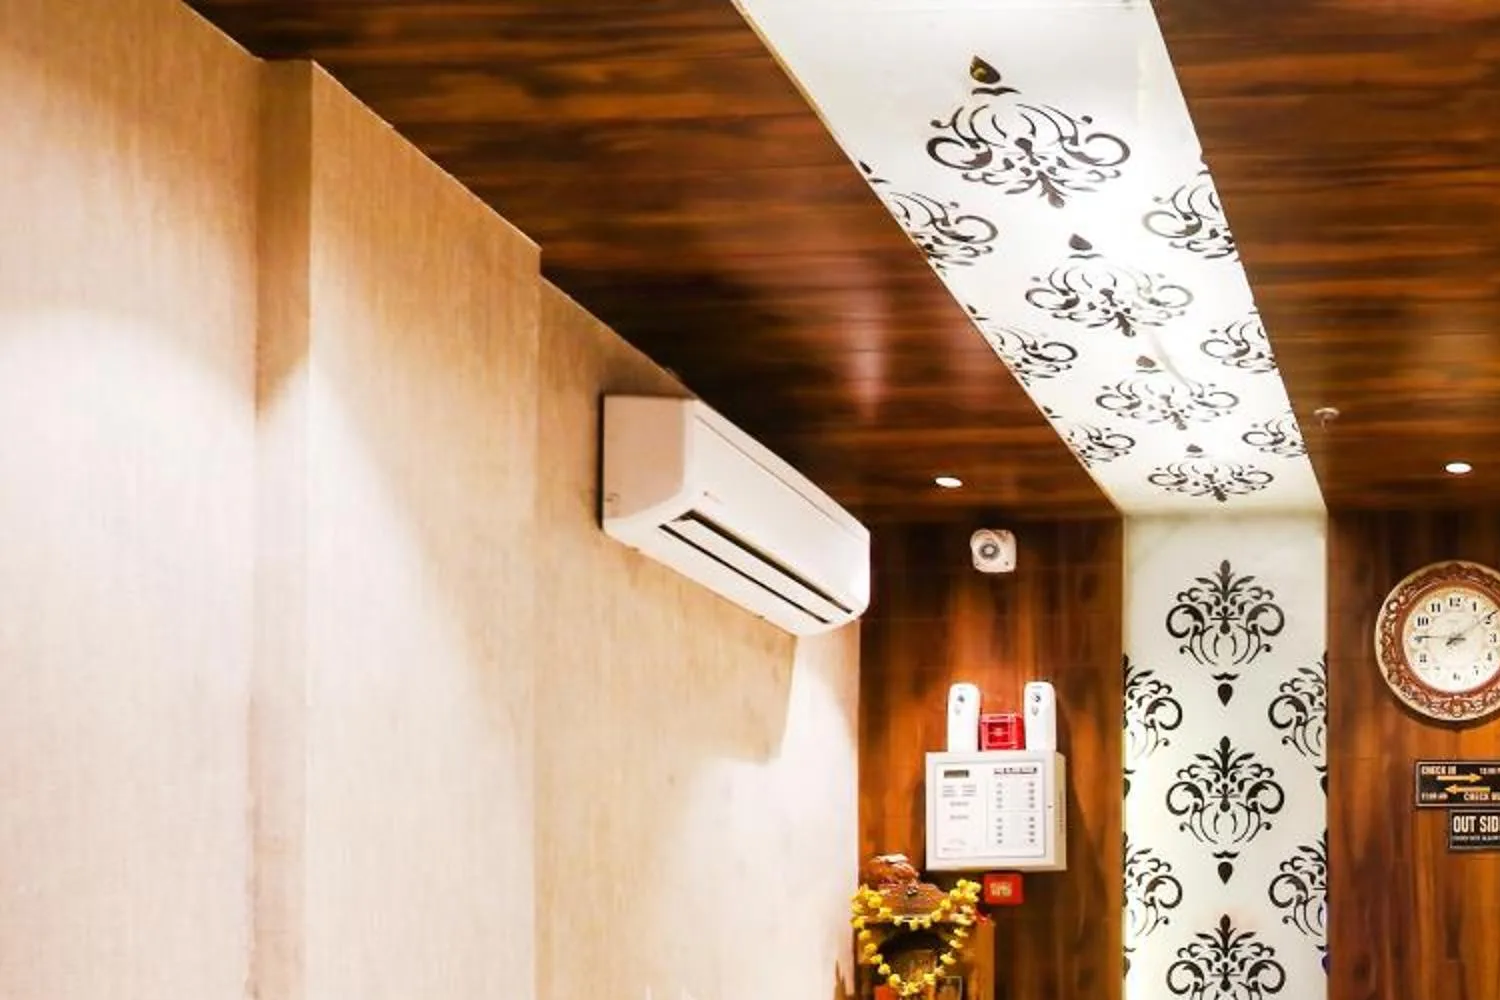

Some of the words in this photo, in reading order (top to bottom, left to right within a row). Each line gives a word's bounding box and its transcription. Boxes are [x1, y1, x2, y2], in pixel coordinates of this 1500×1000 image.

[1431, 603, 1441, 613] 11
[1449, 597, 1462, 608] 12
[1417, 616, 1429, 627] 10
[1453, 815, 1477, 833] OUT
